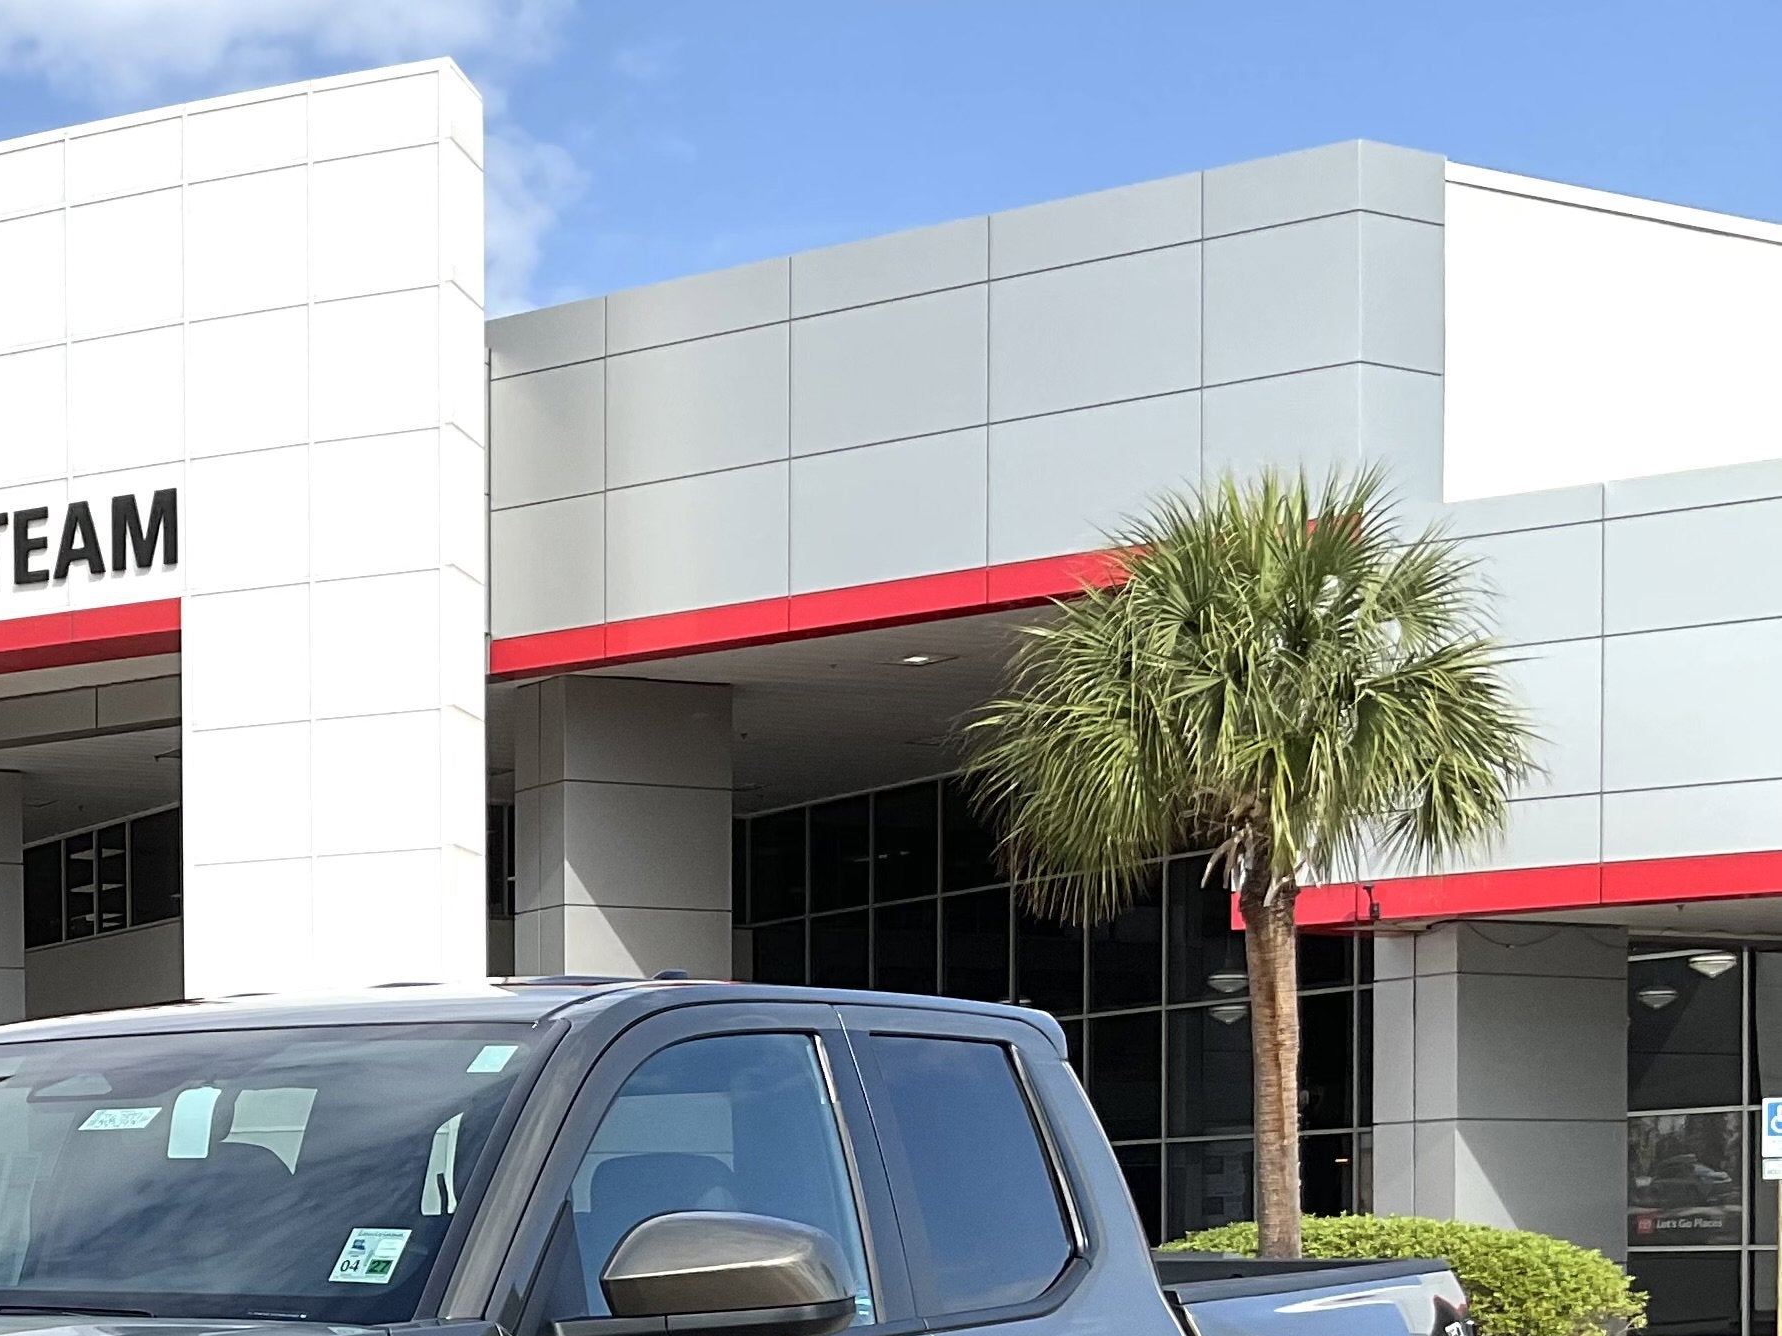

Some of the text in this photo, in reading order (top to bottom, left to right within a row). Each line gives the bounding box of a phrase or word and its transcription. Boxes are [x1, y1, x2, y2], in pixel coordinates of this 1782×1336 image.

[1656, 1219, 1677, 1229] Let's
[1678, 1219, 1693, 1229] Go
[340, 1260, 392, 1272] 04 27
